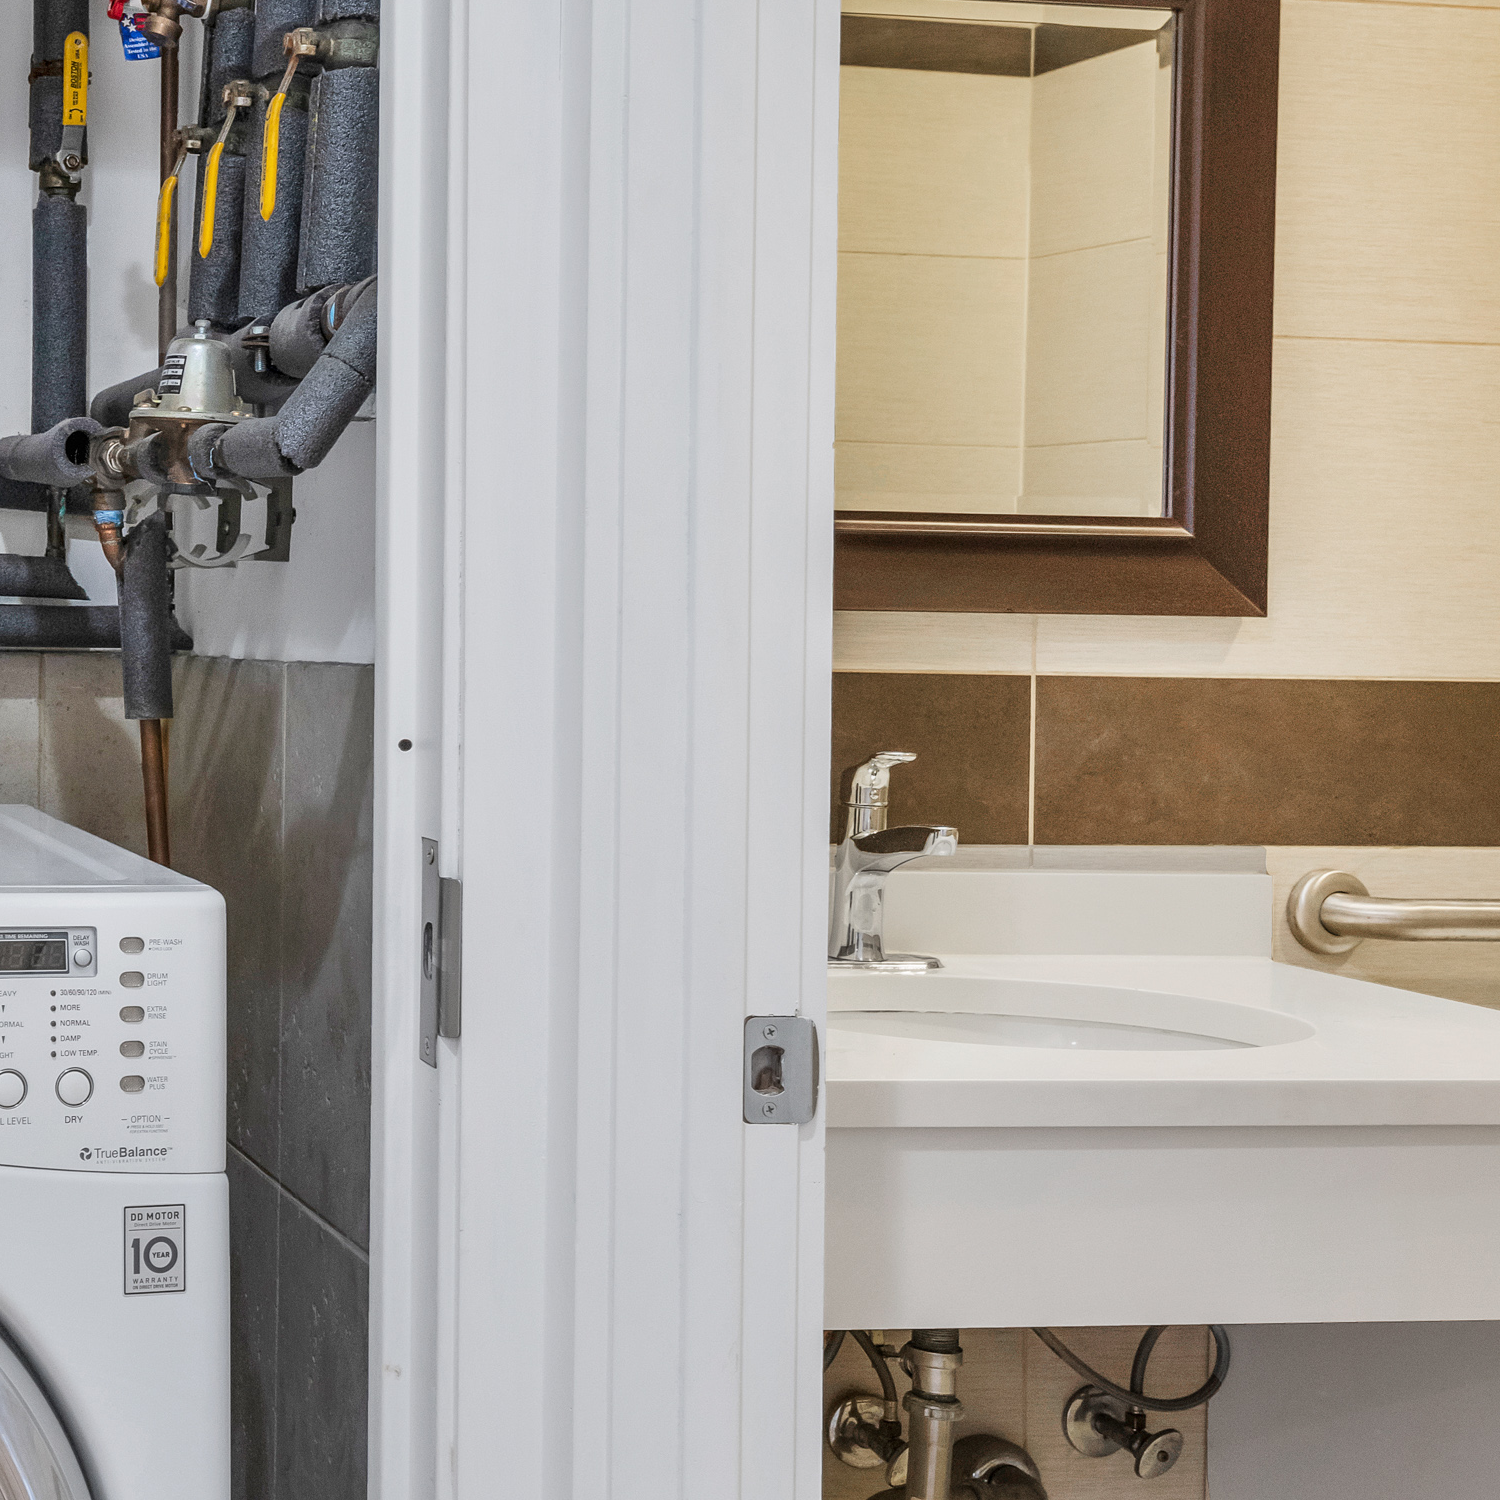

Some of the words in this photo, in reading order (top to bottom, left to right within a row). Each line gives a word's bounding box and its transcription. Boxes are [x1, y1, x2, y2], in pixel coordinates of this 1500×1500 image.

[6, 1116, 32, 1125] LEVEL
[64, 1115, 84, 1124] DRY
[130, 1115, 161, 1123] OPTION
[130, 1213, 143, 1221] DD
[146, 1211, 180, 1220] MOTOR
[131, 1236, 178, 1274] 10
[132, 1276, 179, 1284] WARRANTY
